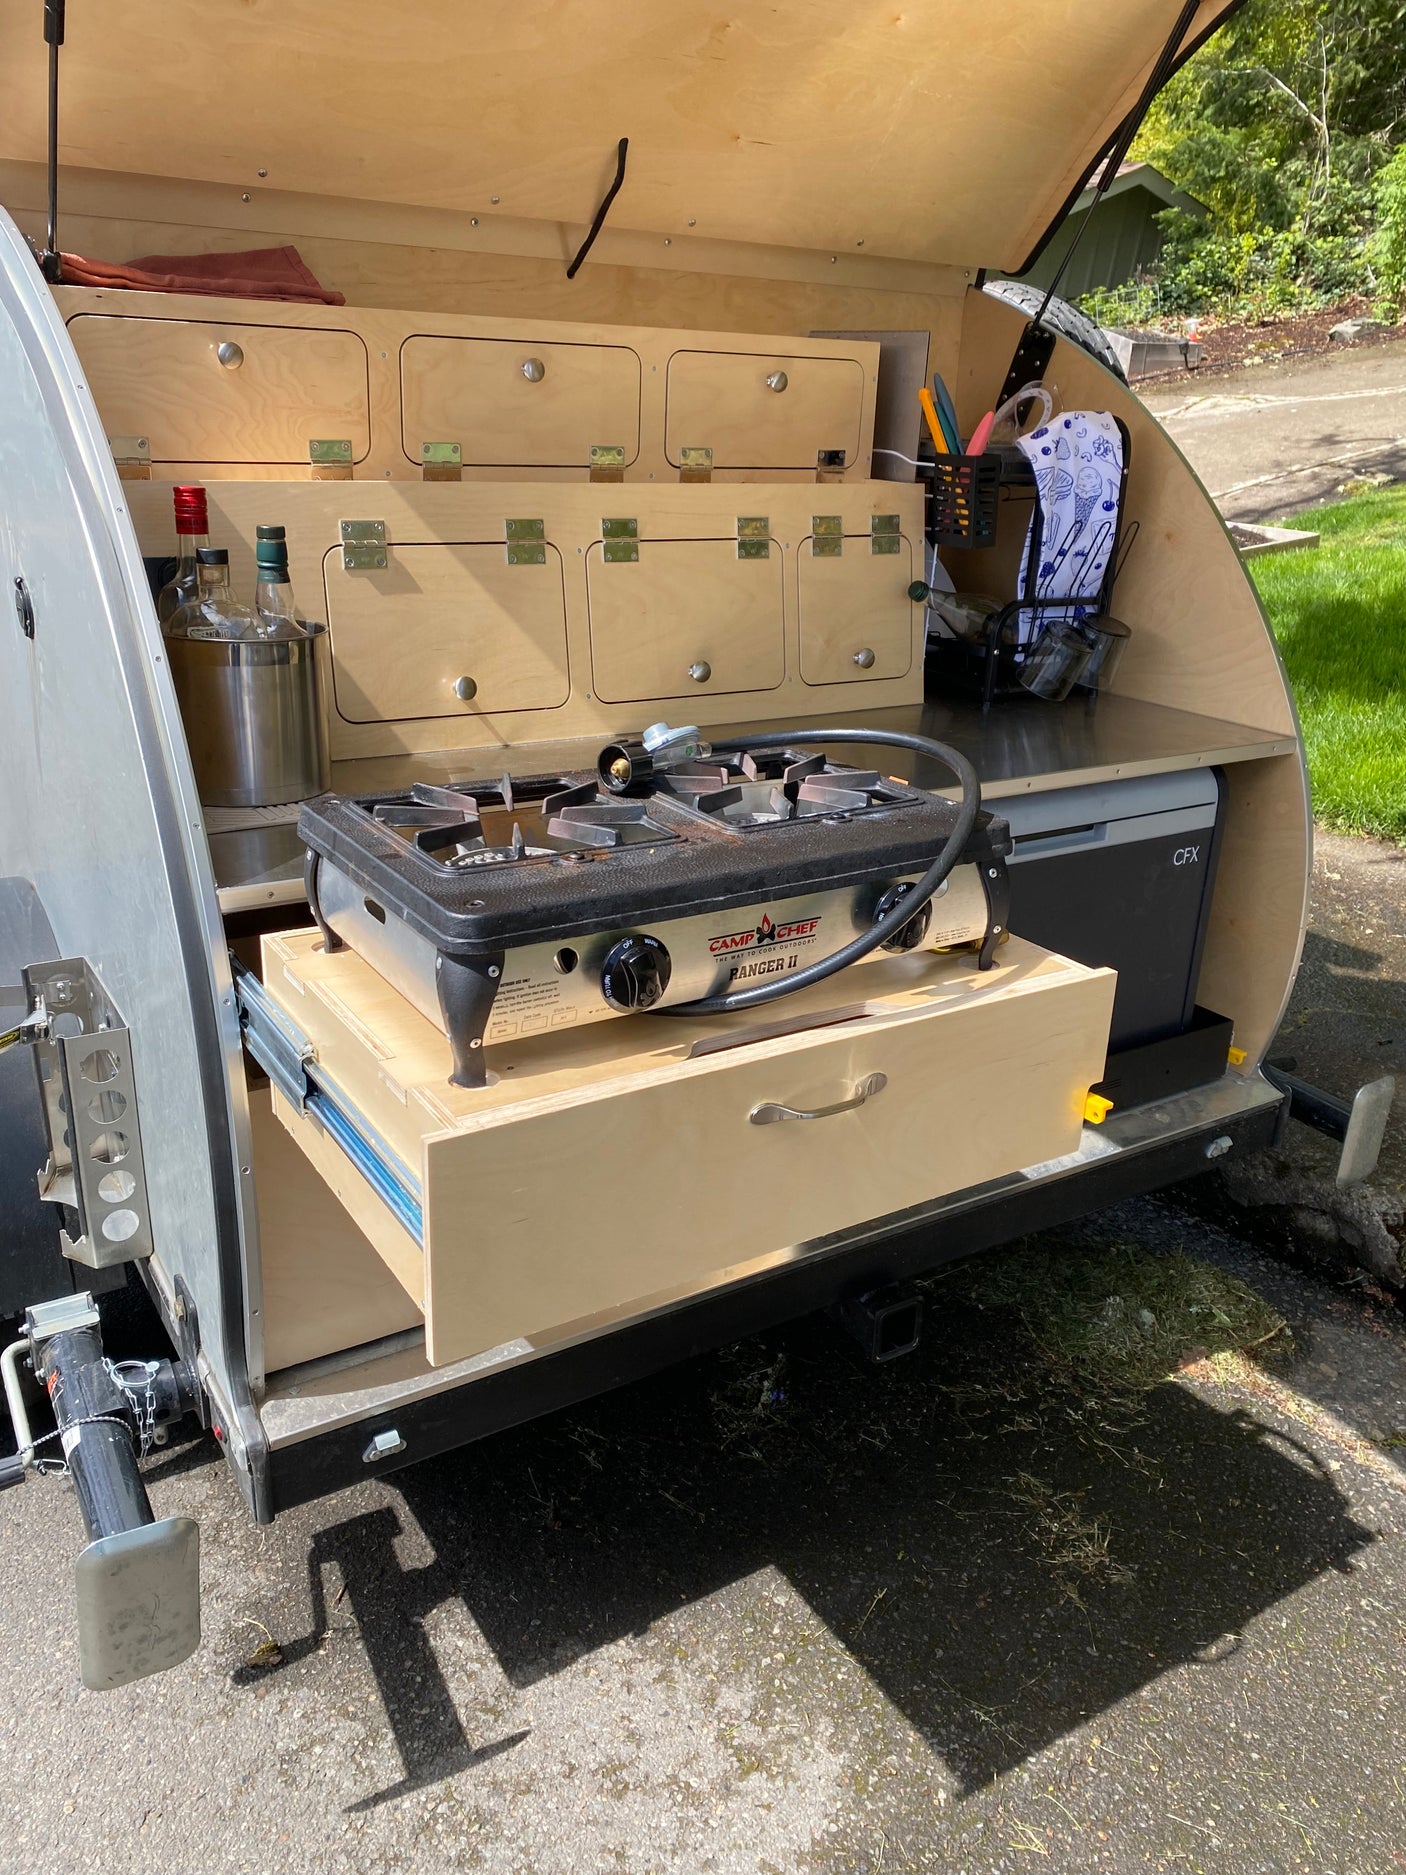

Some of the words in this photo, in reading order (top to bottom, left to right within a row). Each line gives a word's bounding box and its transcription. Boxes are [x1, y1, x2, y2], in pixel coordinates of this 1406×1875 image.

[1174, 846, 1200, 865] CFX
[623, 939, 634, 949] OFF
[709, 933, 755, 952] CAMP
[777, 921, 818, 938] CHEF
[715, 956, 728, 964] THE
[759, 946, 777, 955] COOK
[729, 957, 785, 981] RANGER
[787, 954, 799, 969] II
